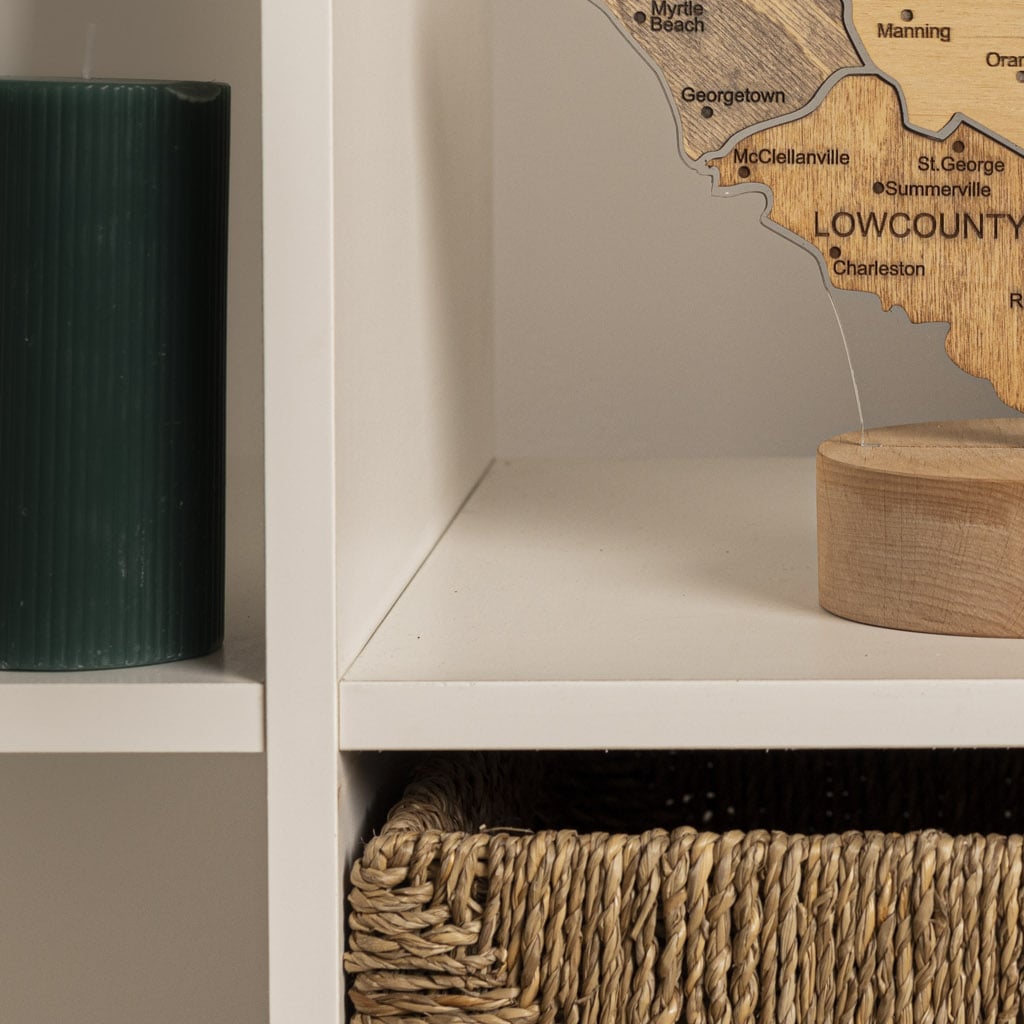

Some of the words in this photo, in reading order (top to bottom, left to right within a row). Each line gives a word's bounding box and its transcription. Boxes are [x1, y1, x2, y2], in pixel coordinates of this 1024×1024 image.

[650, 0, 704, 17] Myrtle
[650, 17, 705, 33] Beach
[877, 23, 951, 42] Manning
[681, 87, 786, 105] Georgetown
[733, 150, 850, 166] McClellanville
[885, 181, 991, 197] Summerville
[833, 260, 925, 277] Charleston
